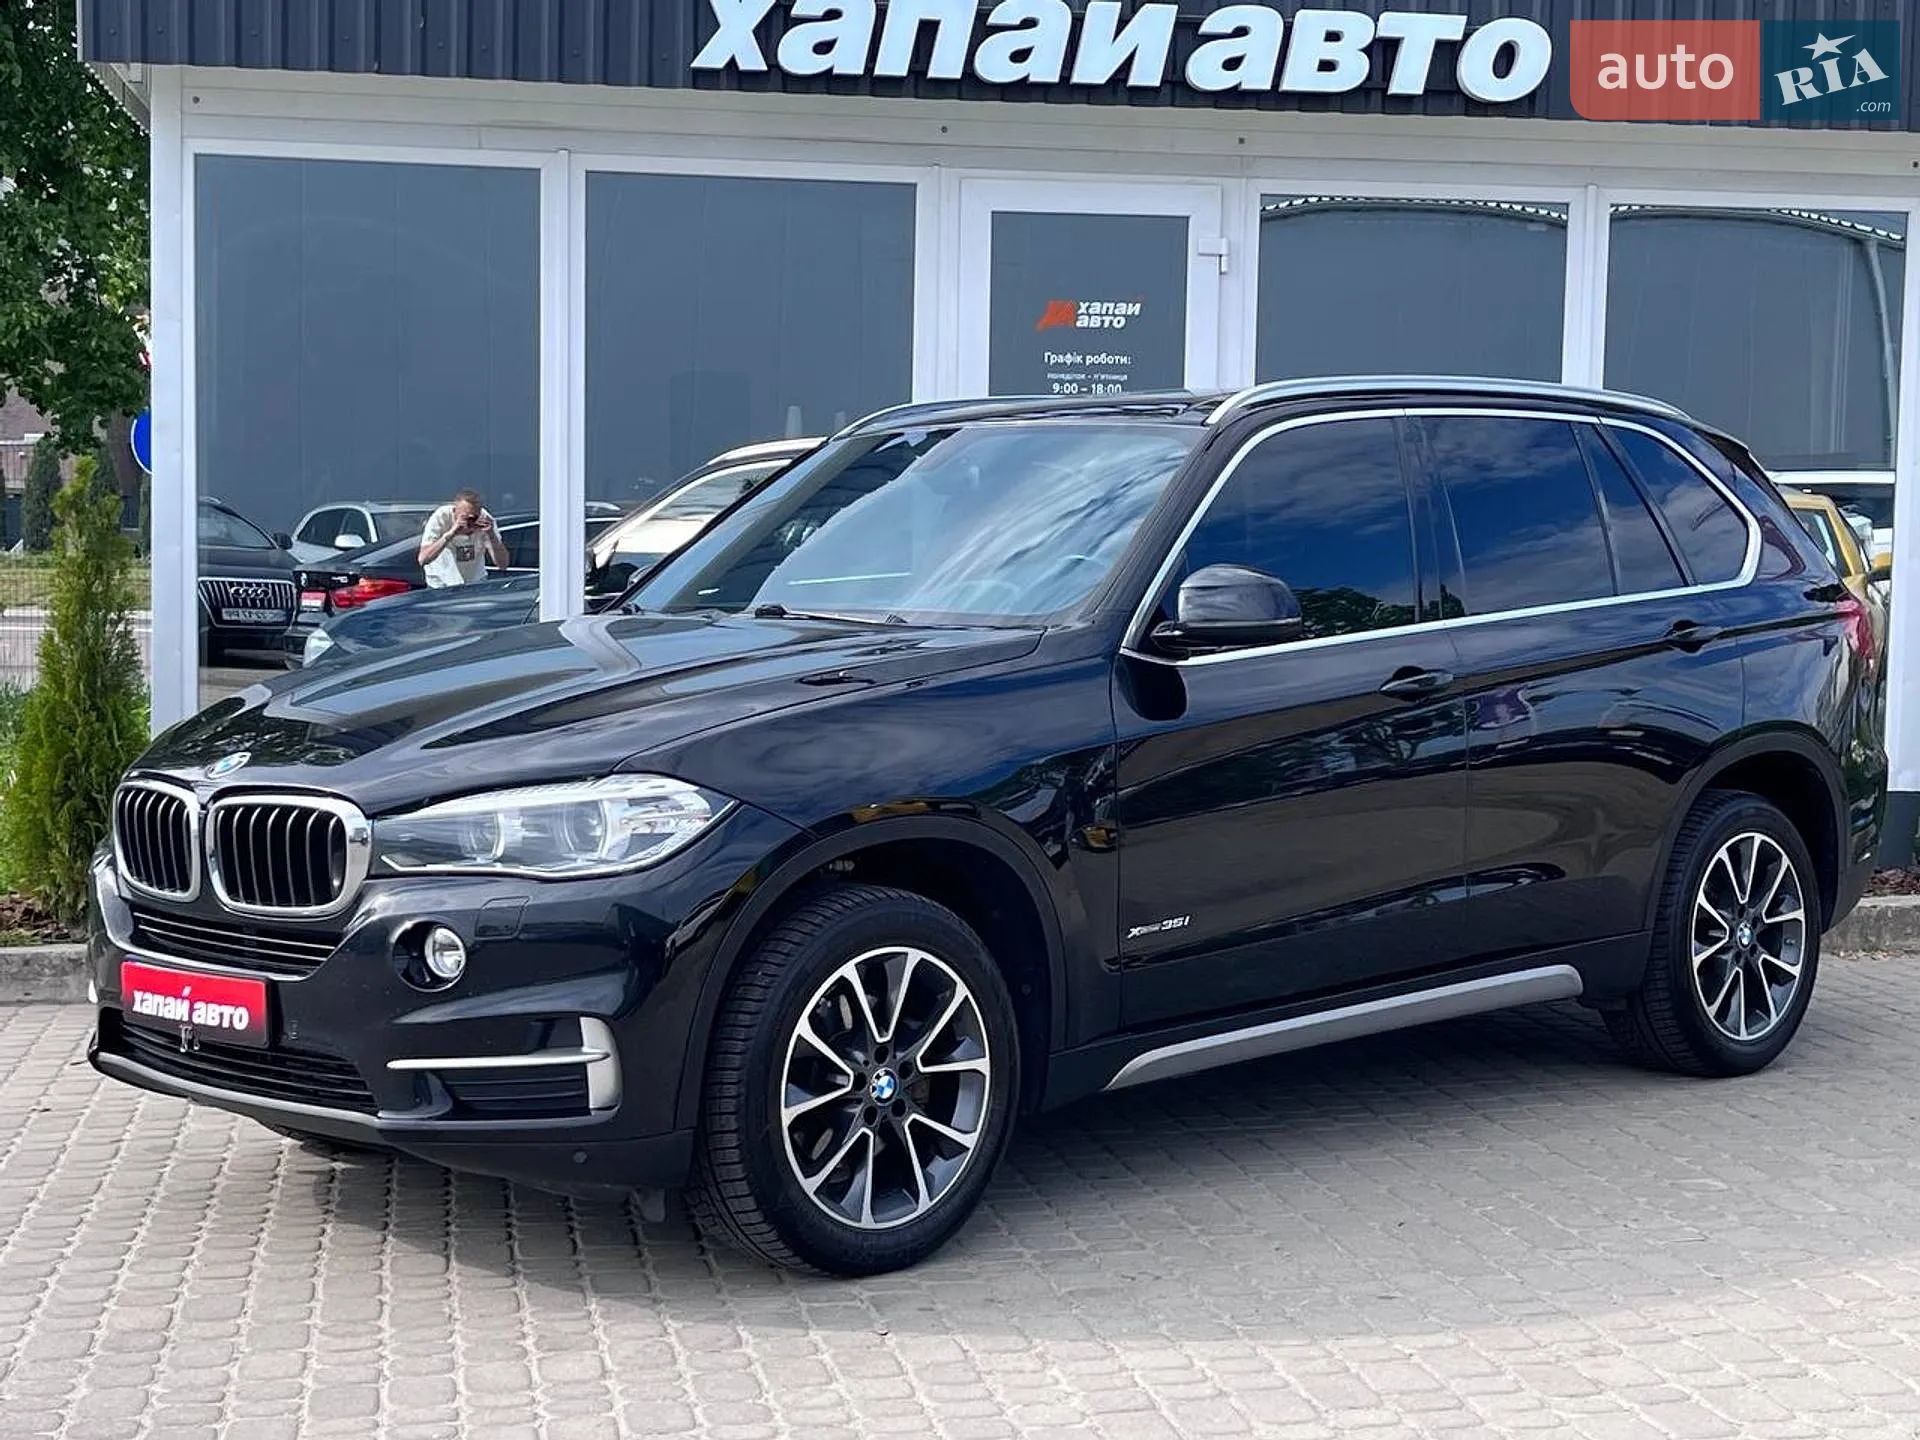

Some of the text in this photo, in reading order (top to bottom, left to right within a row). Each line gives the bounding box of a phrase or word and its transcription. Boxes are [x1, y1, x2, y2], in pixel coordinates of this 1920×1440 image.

[1184, 4, 1553, 102] авто
[1075, 315, 1127, 329] авто
[1043, 352, 1132, 366] Графік роботи:
[1052, 383, 1079, 394] 9:00
[1090, 384, 1122, 395] 18:00
[132, 985, 250, 1031] хапай авто
